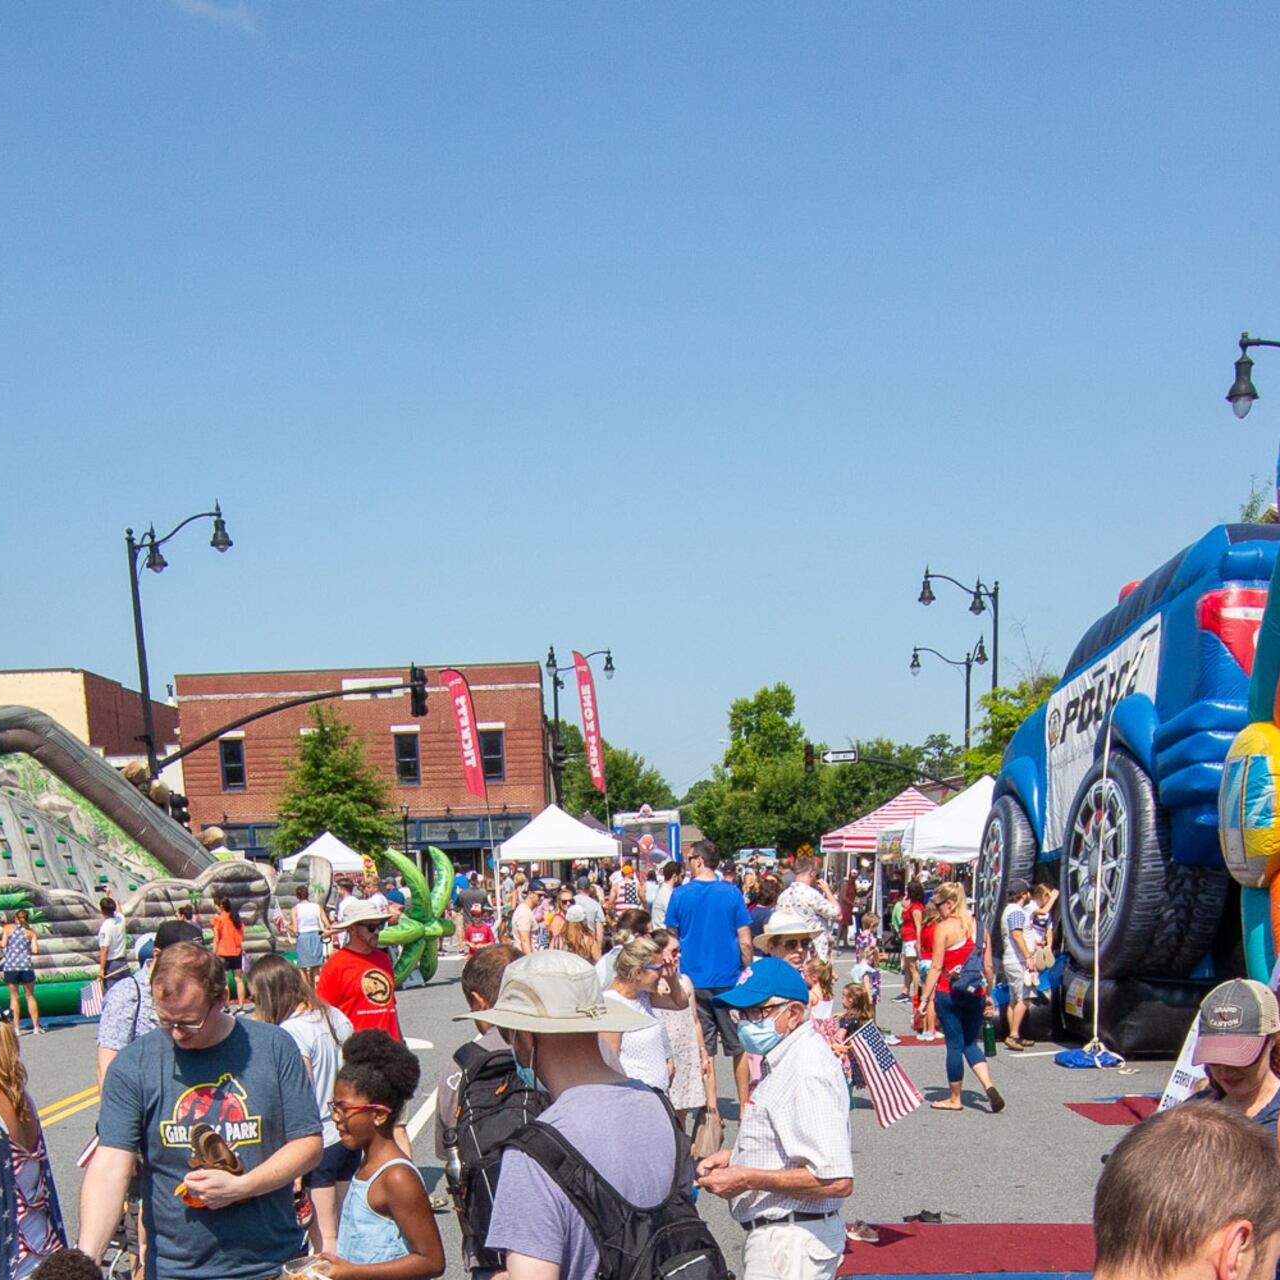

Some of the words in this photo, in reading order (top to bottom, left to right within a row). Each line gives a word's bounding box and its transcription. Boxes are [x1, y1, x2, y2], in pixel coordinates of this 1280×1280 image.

[1214, 1006, 1237, 1014] GRAND
[1210, 1018, 1239, 1028] CANYON
[225, 1121, 258, 1142] PARK
